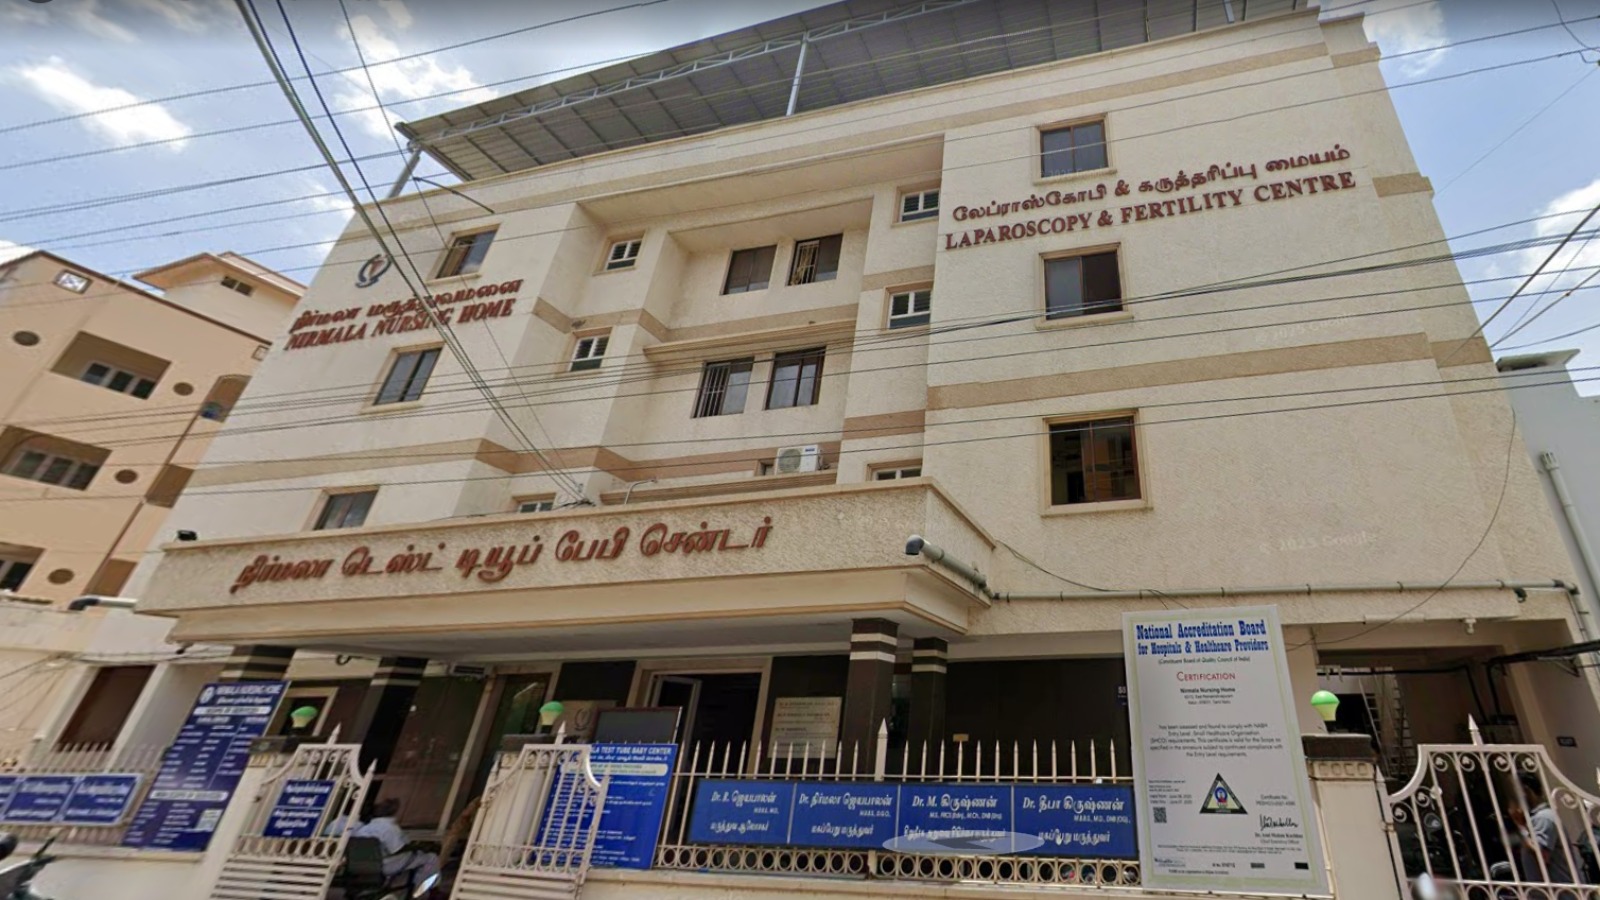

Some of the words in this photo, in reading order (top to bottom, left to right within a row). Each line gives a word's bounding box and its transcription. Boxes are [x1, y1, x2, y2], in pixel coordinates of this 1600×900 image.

[1114, 179, 1130, 197] &
[1138, 161, 1258, 193] கருத்தரிப்பு
[1265, 144, 1351, 172] மையம்
[945, 212, 1093, 250] LAPAROSCOPY
[1097, 210, 1113, 227] &
[1120, 189, 1244, 224] FERTILITY
[1253, 171, 1356, 202] CENTRE
[289, 308, 362, 333] நிர்மலா
[367, 279, 523, 316] மருத்துவமனை
[284, 323, 367, 350] NIRMALA
[371, 308, 453, 338] NURSING
[457, 299, 517, 324] HOME
[229, 554, 335, 594] நிர்மலா
[341, 542, 446, 577] டெஸ்ட்
[455, 535, 545, 583] டியூப்
[555, 526, 630, 561] பேபி
[1136, 624, 1173, 640] National
[1178, 622, 1235, 639] Accreditation
[1238, 619, 1266, 636] Board
[1138, 643, 1148, 655] for
[1151, 641, 1182, 657] Hospitals
[1184, 641, 1192, 653] &
[1195, 639, 1232, 653] Healthcare
[1234, 638, 1269, 651] Providers
[1177, 671, 1236, 681] CERTIFICATION
[601, 747, 615, 755] TEST
[616, 747, 631, 755] TUBE
[631, 747, 647, 755] BABY
[648, 747, 672, 755] CENTER
[711, 791, 721, 802] Dr.
[798, 793, 809, 805] Dr.
[912, 795, 924, 807] Dr.
[926, 795, 937, 807] M.
[940, 793, 998, 811] கிருஷ்ணன்
[1023, 797, 1036, 809] Dr.
[1063, 795, 1126, 814] கிருஷ்ணன்
